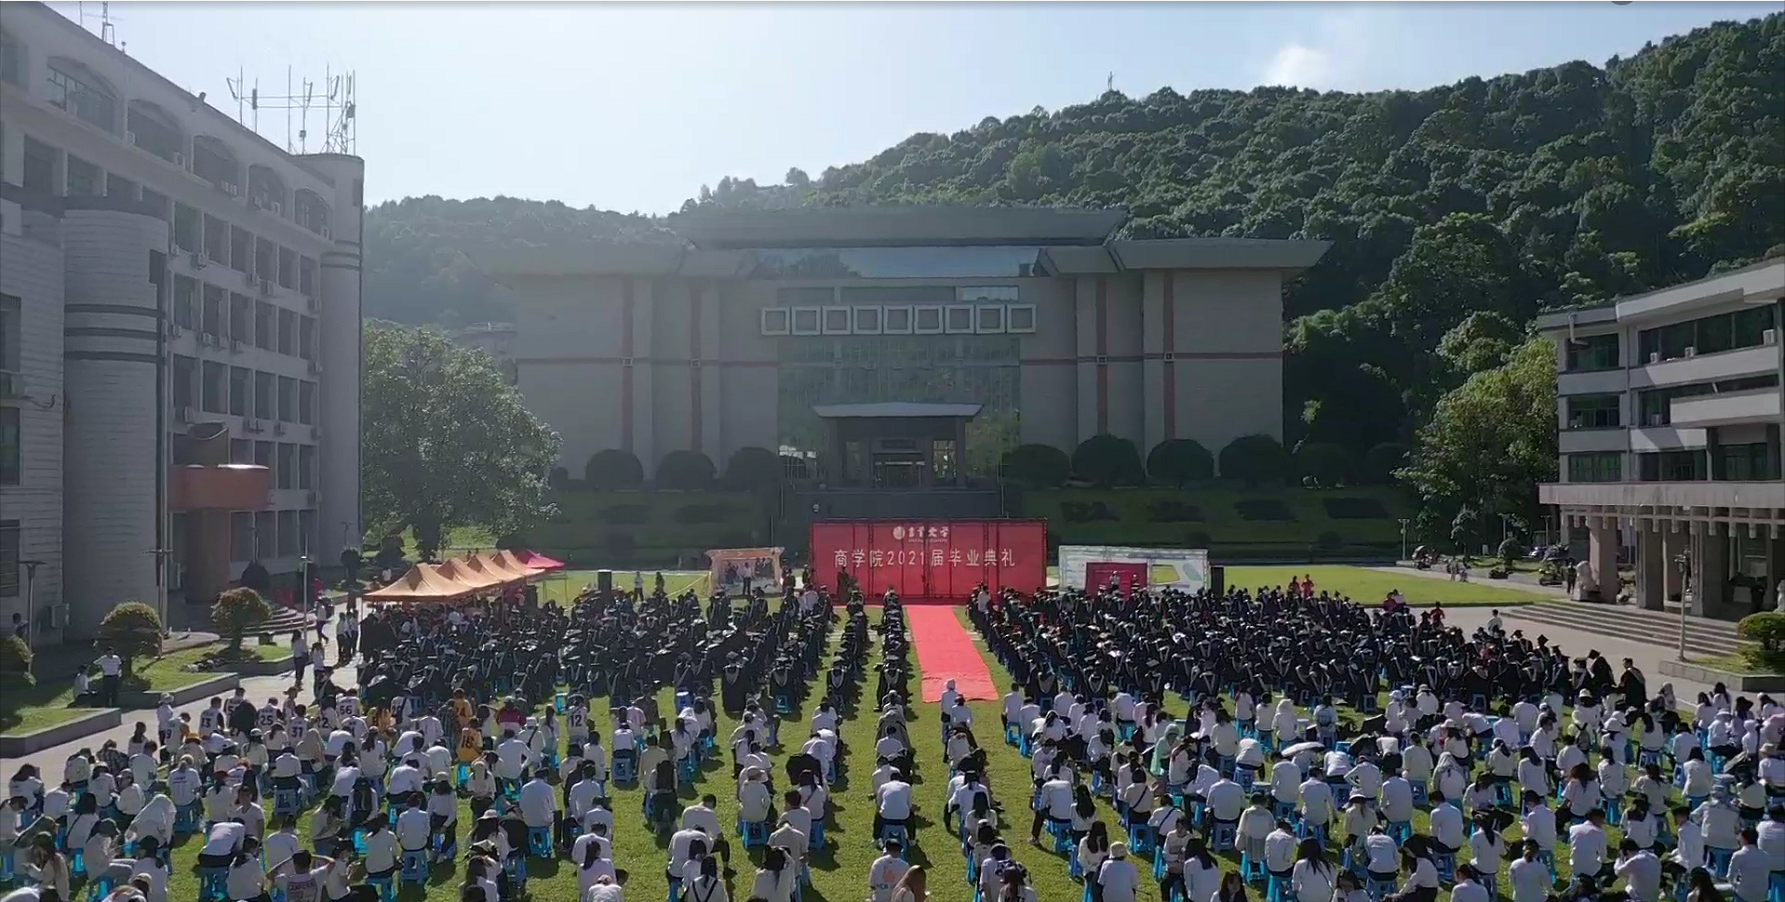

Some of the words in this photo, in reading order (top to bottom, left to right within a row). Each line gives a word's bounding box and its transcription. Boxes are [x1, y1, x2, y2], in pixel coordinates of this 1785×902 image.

[834, 549, 1015, 567] 商学院2021届毕业典礼
[568, 714, 583, 728] 12
